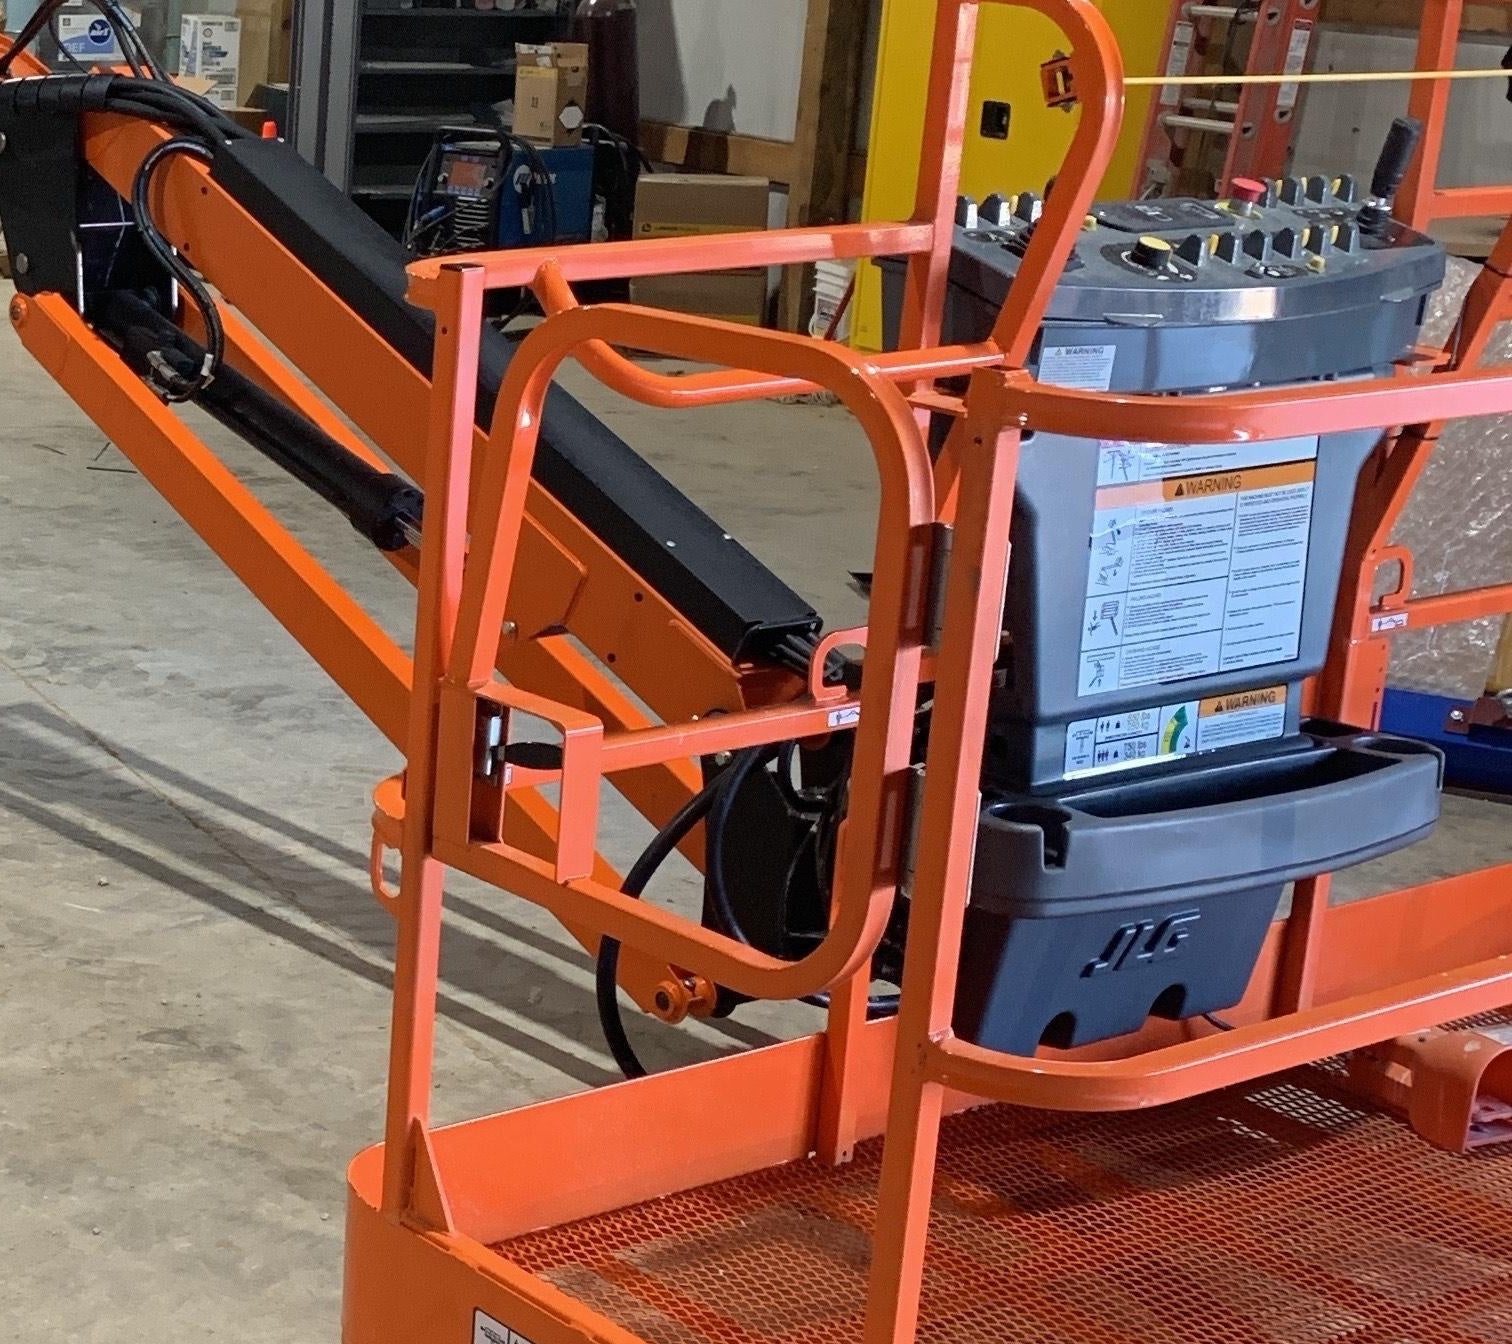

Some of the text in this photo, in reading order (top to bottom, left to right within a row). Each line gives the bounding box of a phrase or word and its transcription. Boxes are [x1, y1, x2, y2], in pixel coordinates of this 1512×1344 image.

[1065, 346, 1104, 355] WARNING
[1186, 474, 1243, 496] WARNING
[1225, 690, 1277, 711] WARNING
[1079, 908, 1201, 978] JLG
